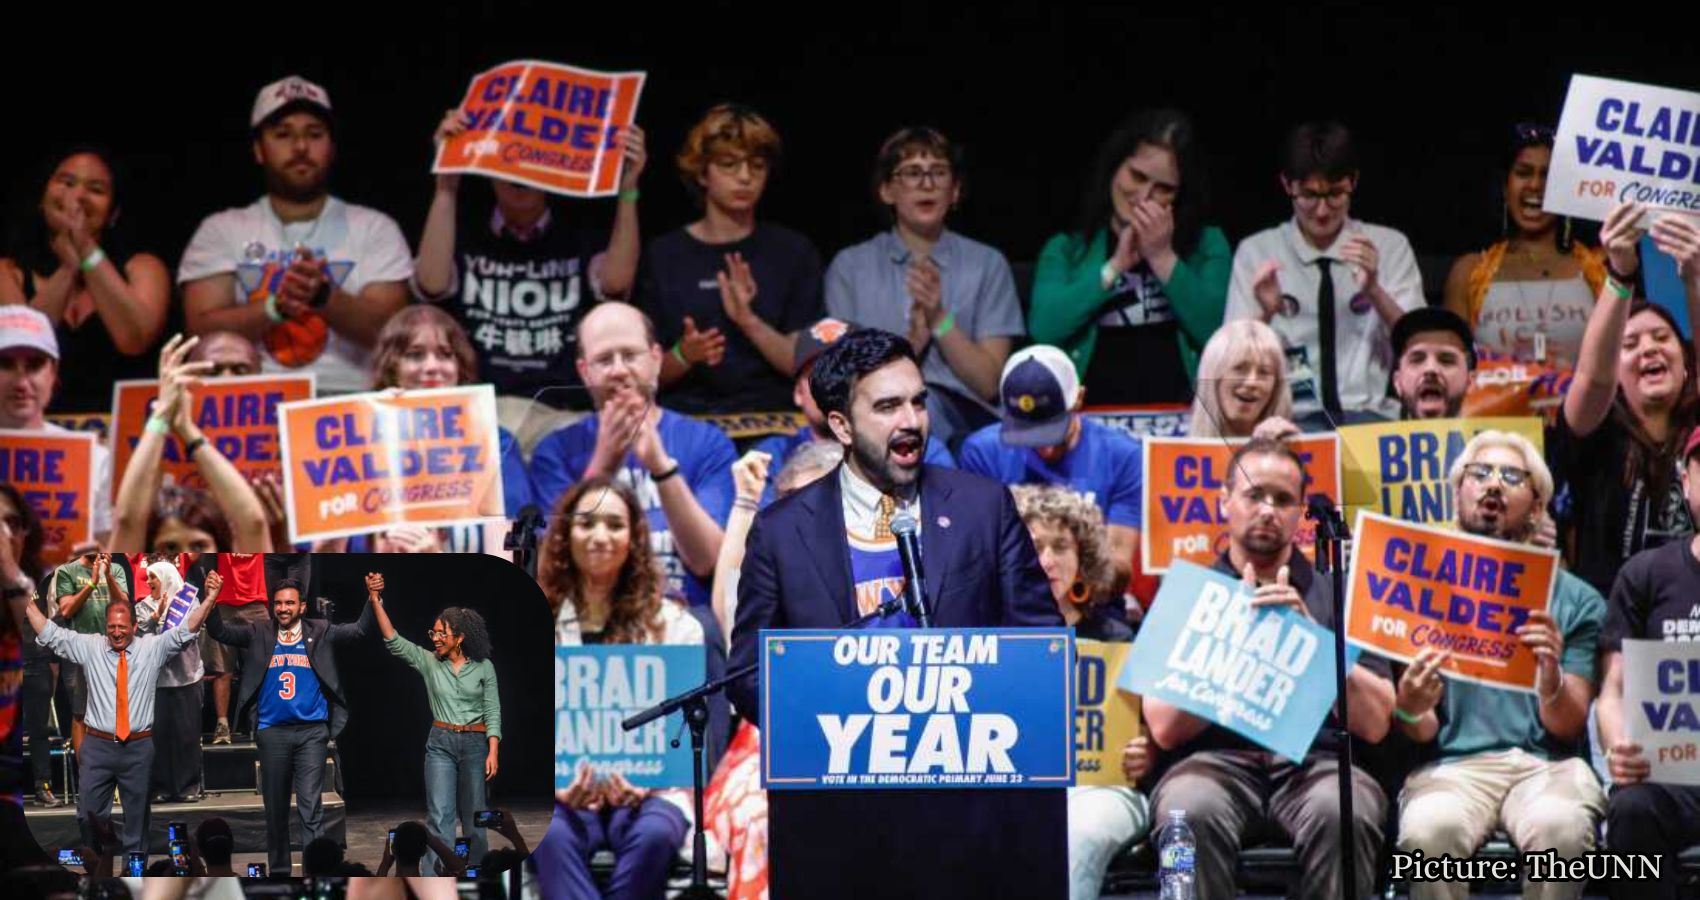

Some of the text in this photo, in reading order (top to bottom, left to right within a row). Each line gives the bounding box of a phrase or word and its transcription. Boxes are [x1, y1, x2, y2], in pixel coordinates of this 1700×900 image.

[1576, 180, 1616, 198] FOR
[463, 270, 580, 317] NIOU
[144, 391, 284, 429] AIRE
[315, 406, 465, 450] CLAIRE
[303, 444, 485, 487] VALDEZ
[1379, 430, 1480, 483] BRA
[319, 493, 359, 519] FOR
[1172, 533, 1210, 555] FOR
[1383, 536, 1526, 598] CLAIRE
[1366, 570, 1531, 636] VALDEZ
[834, 635, 998, 666] OUR TEAM
[1187, 580, 1318, 677] BRAD
[1371, 615, 1517, 660] FOR CONGRESS
[279, 671, 296, 700] 3
[867, 665, 972, 714] OUR
[1166, 628, 1295, 717] LANDER
[1188, 681, 1274, 731] Congress
[555, 709, 666, 755] ANDER
[816, 713, 1019, 774] YEAR
[1657, 743, 1697, 762] FOR
[821, 774, 1024, 785] VOTE IN THE DEMOCRATIC PRIMARY JUNE 23
